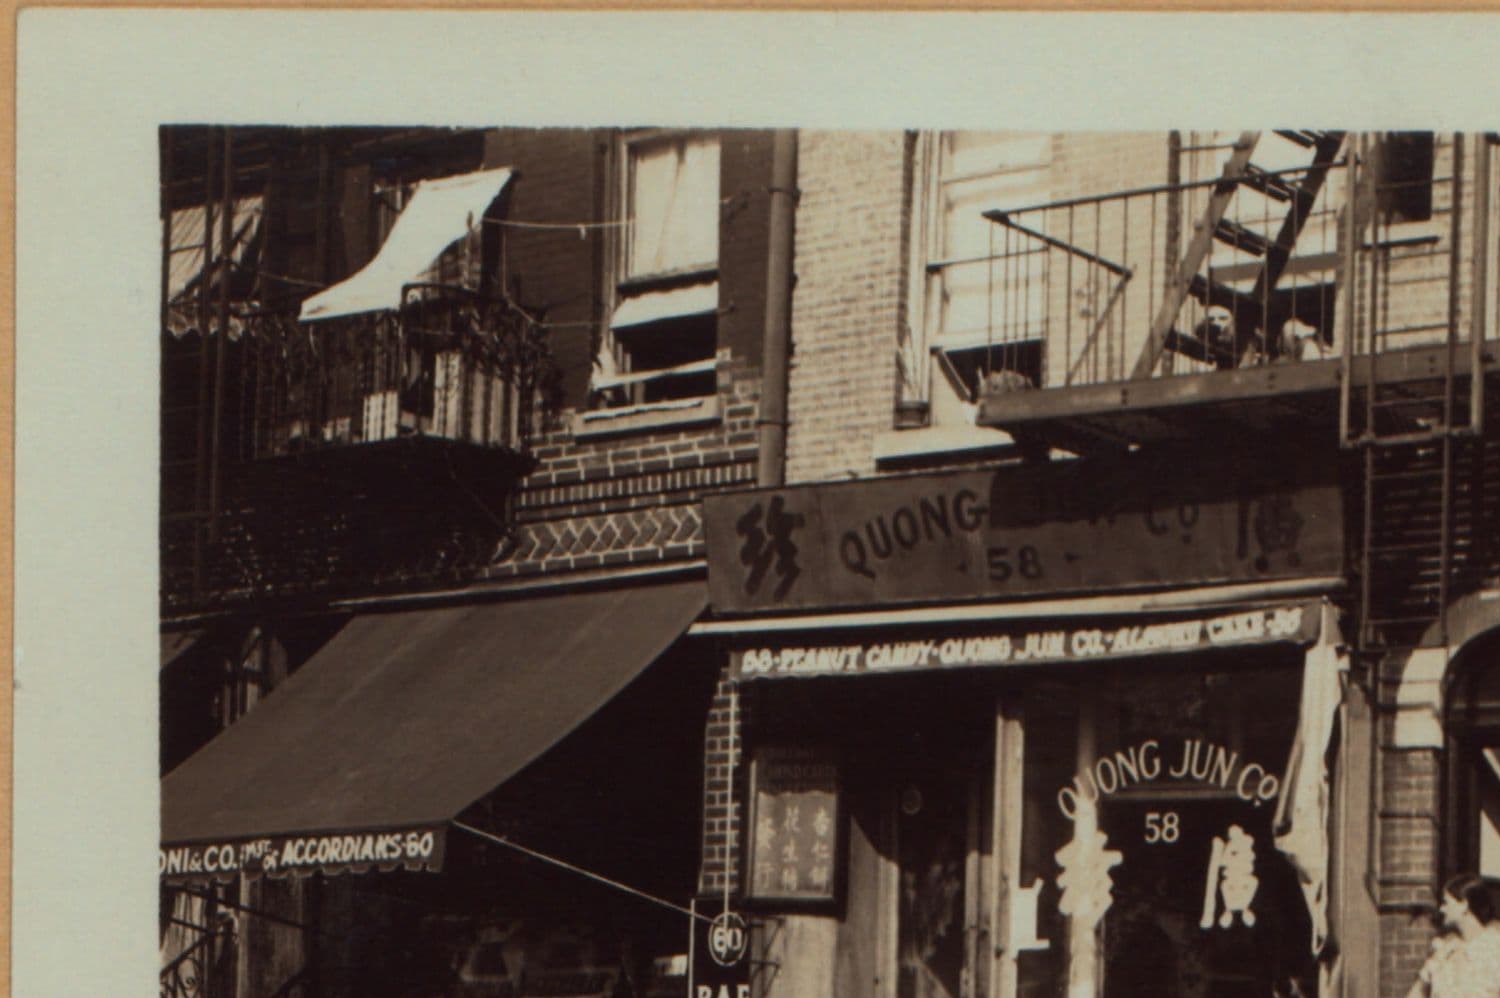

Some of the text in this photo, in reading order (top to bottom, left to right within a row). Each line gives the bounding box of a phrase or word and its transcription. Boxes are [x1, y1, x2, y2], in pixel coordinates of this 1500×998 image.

[840, 488, 989, 581] QUONG
[987, 545, 1041, 582] 58
[1169, 740, 1238, 788] JUN
[1144, 812, 1180, 843] 58
[712, 927, 743, 953] 60
